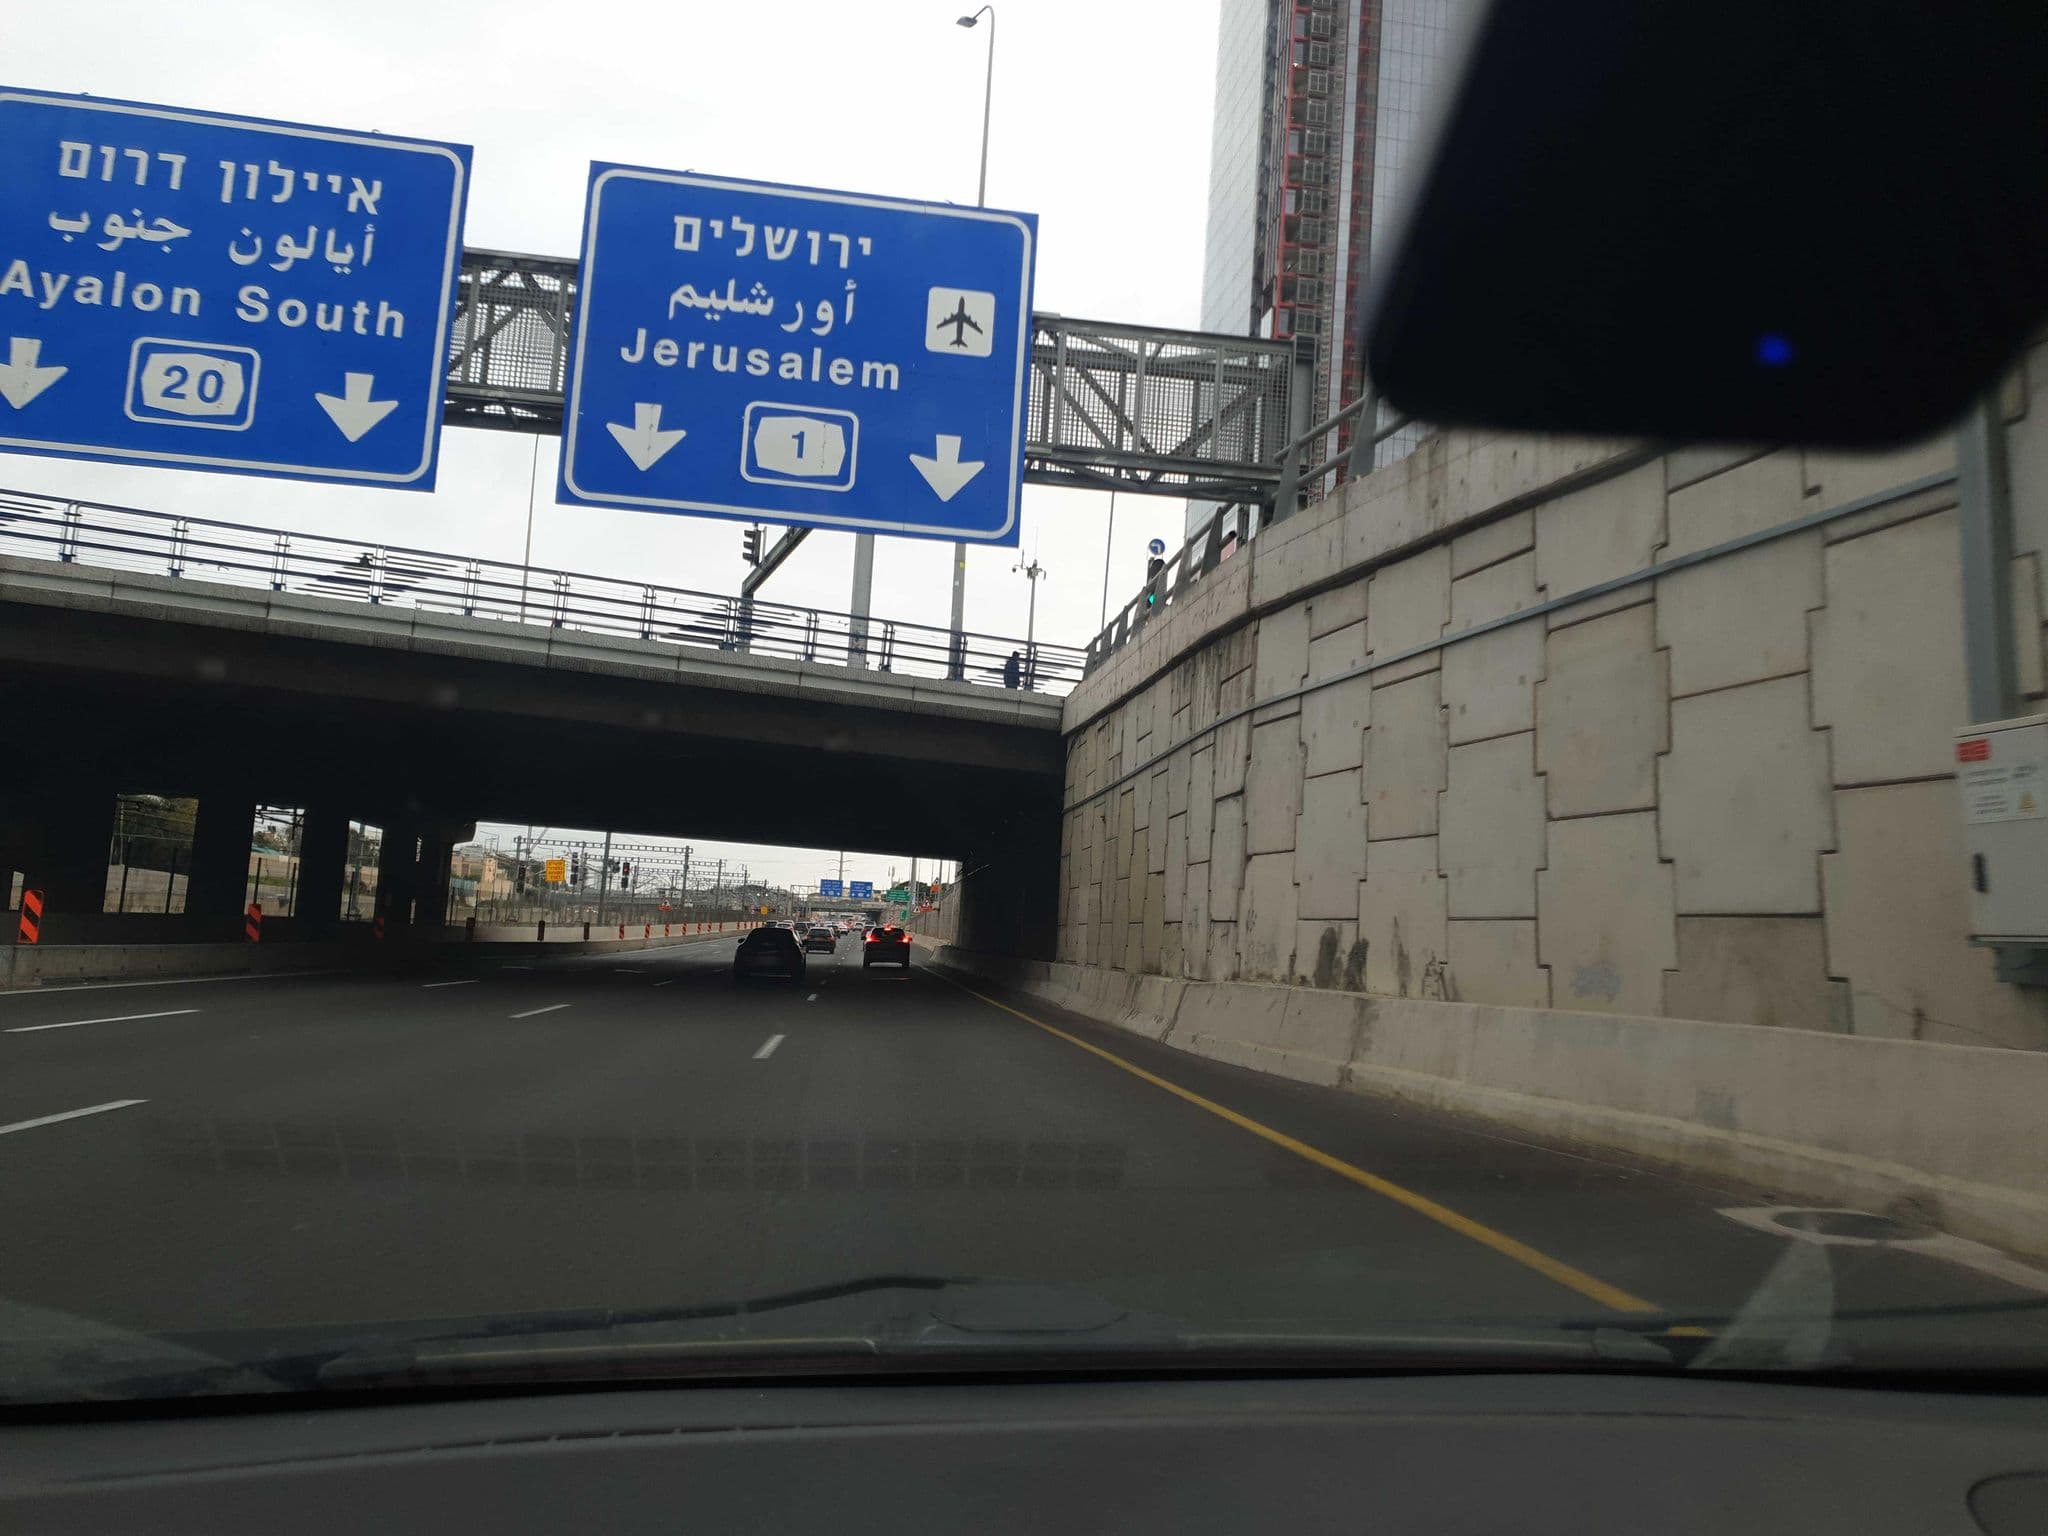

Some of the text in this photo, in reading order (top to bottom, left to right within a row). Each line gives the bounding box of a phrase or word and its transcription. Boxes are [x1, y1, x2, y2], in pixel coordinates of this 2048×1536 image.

[59, 140, 382, 215] איילון דרום
[48, 208, 375, 274] أيالون جنوب
[673, 215, 872, 269] ירושלים
[0, 259, 404, 338] Ayalon South
[161, 364, 225, 404] 20
[620, 327, 899, 391] Jerusalem
[791, 431, 805, 459] 1
